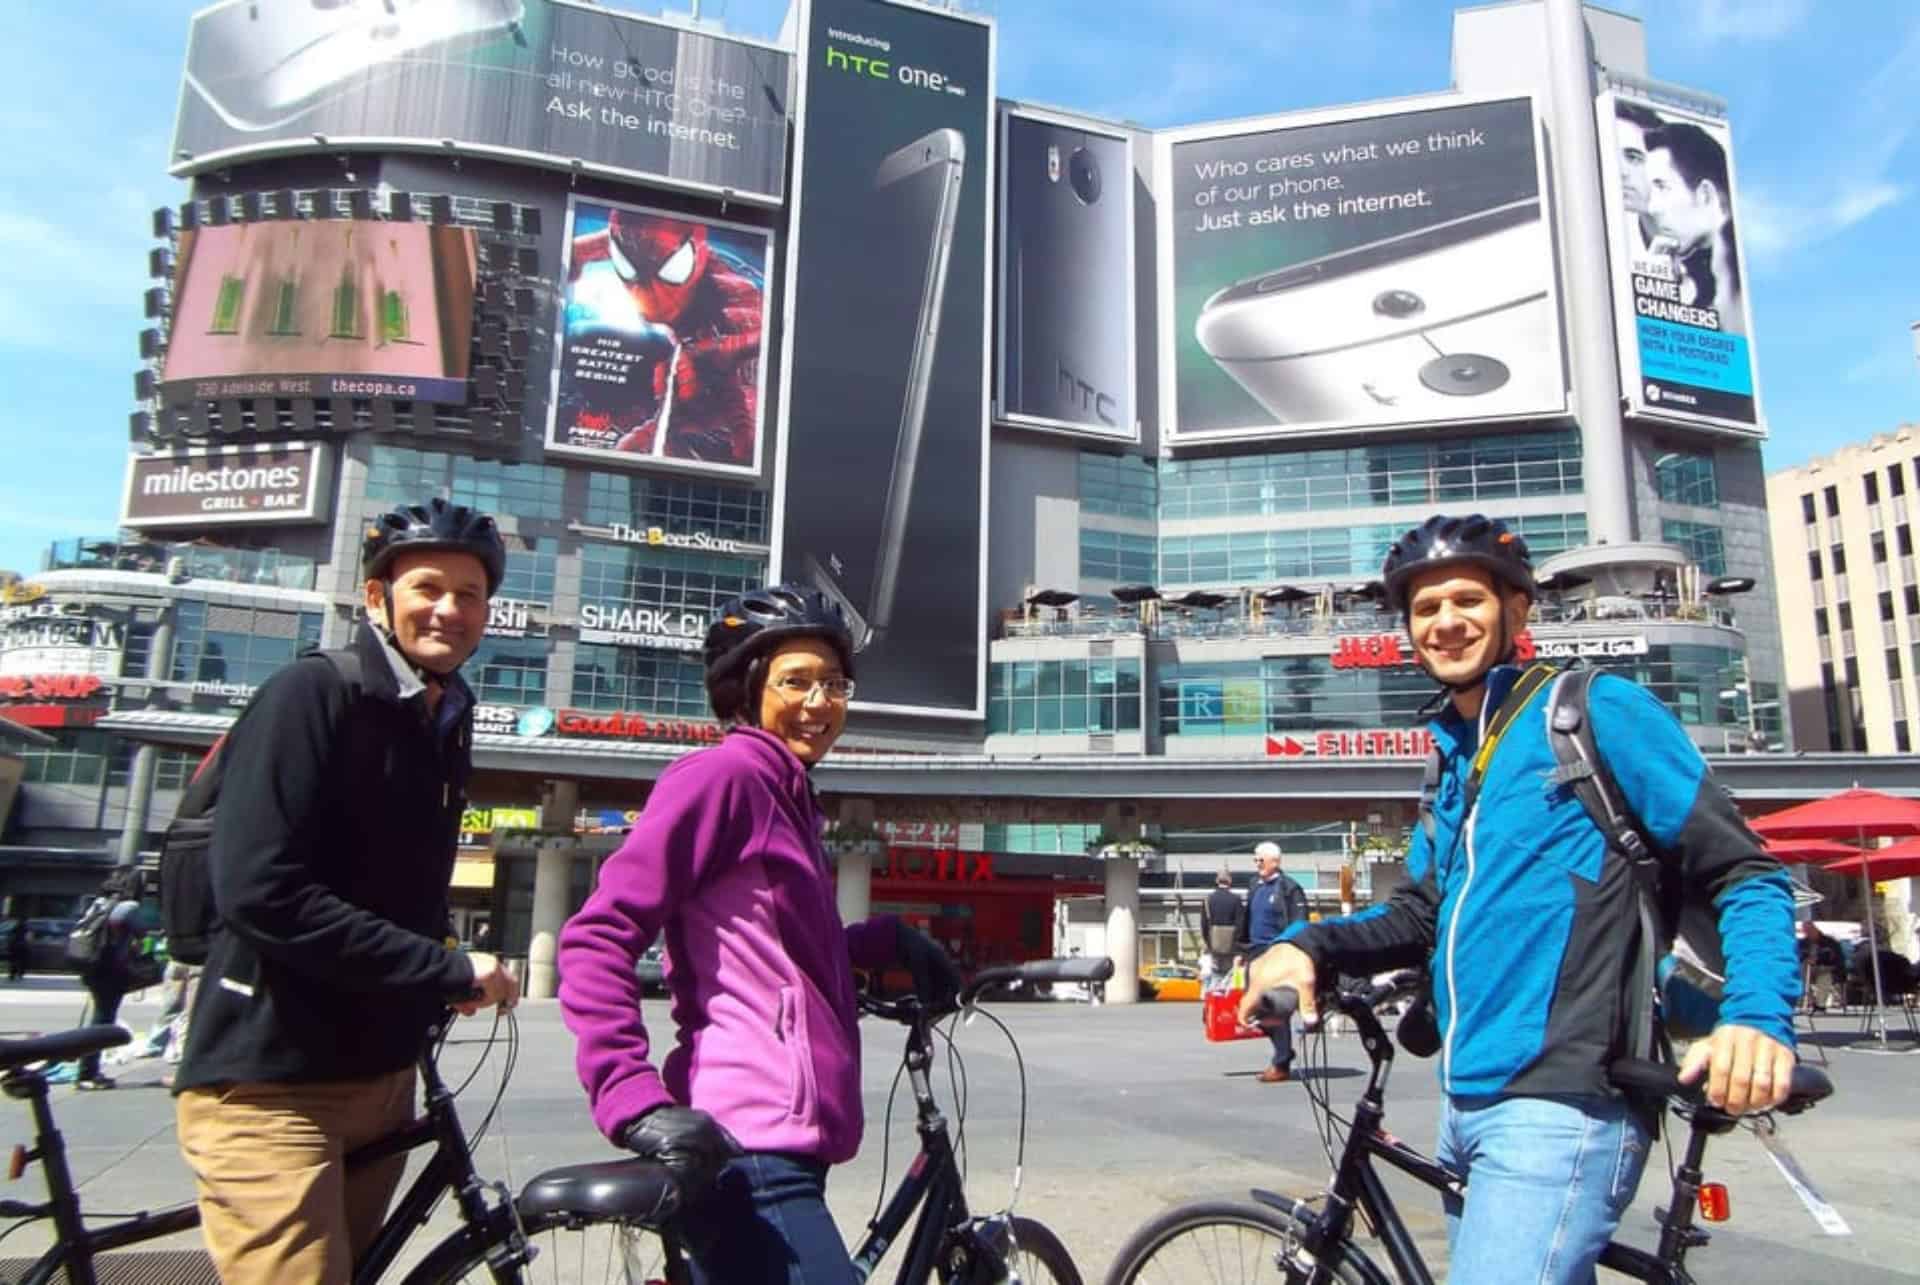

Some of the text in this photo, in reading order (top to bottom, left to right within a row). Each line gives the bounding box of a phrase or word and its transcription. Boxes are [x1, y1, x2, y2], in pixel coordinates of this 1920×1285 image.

[551, 45, 604, 68] How
[614, 60, 675, 85] good
[546, 71, 571, 90] all
[579, 80, 625, 101] new
[634, 89, 680, 113] HTC
[546, 96, 741, 150] Ask the internet.
[1195, 128, 1486, 180] Who cares what we think
[1195, 173, 1344, 206] of our phone.
[1195, 188, 1432, 232] Just ask the internet.
[1634, 276, 1680, 301] GAME
[1637, 297, 1719, 329] CHANGERS
[143, 465, 301, 496] milestones
[202, 494, 300, 510] GRILL BAR
[581, 605, 671, 634] SHARK
